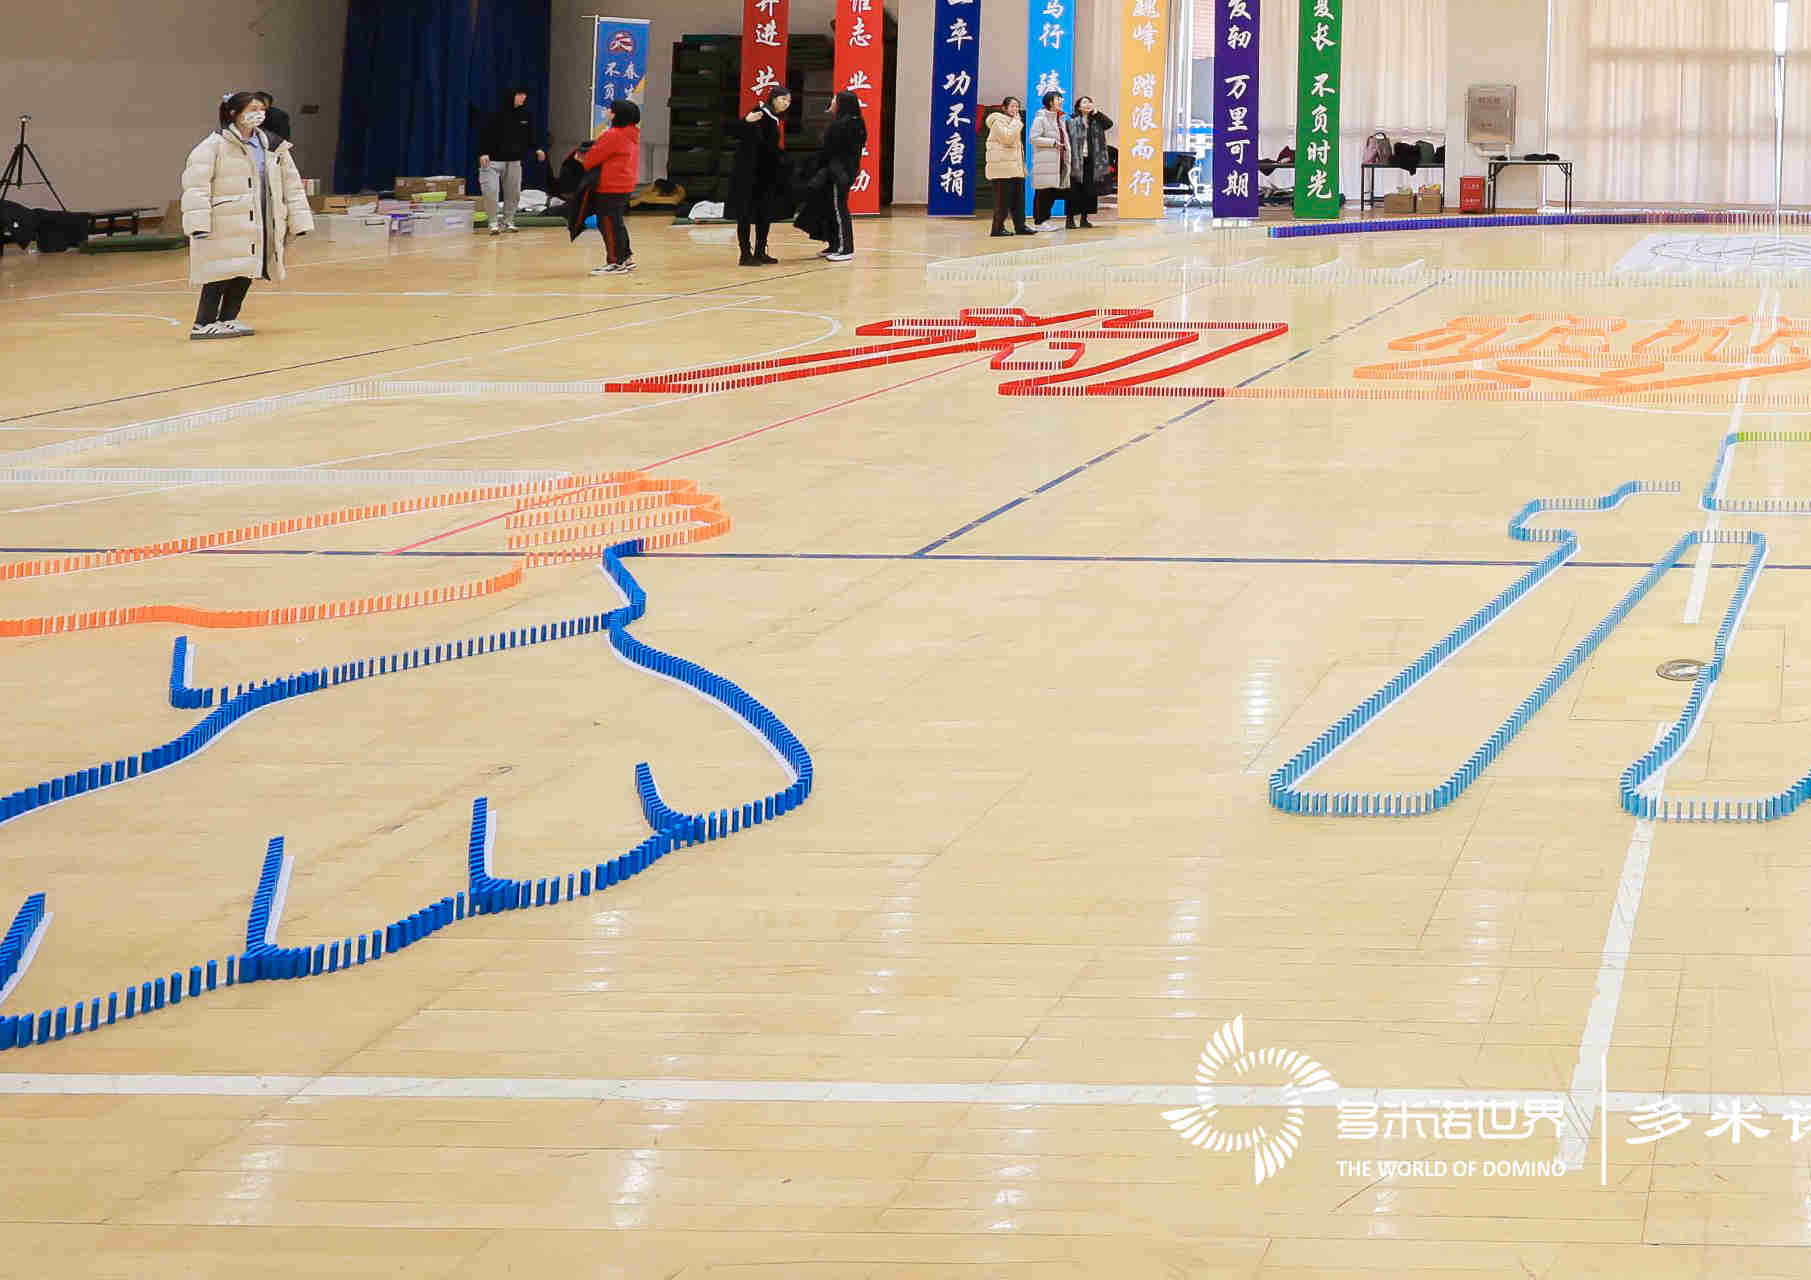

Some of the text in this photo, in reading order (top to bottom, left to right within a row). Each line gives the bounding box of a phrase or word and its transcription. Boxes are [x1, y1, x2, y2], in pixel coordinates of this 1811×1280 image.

[940, 70, 971, 197] 功不唐捐
[1128, 73, 1160, 197] 踏浪而行
[1221, 74, 1251, 198] 万里可期
[1306, 73, 1336, 200] 不负时光
